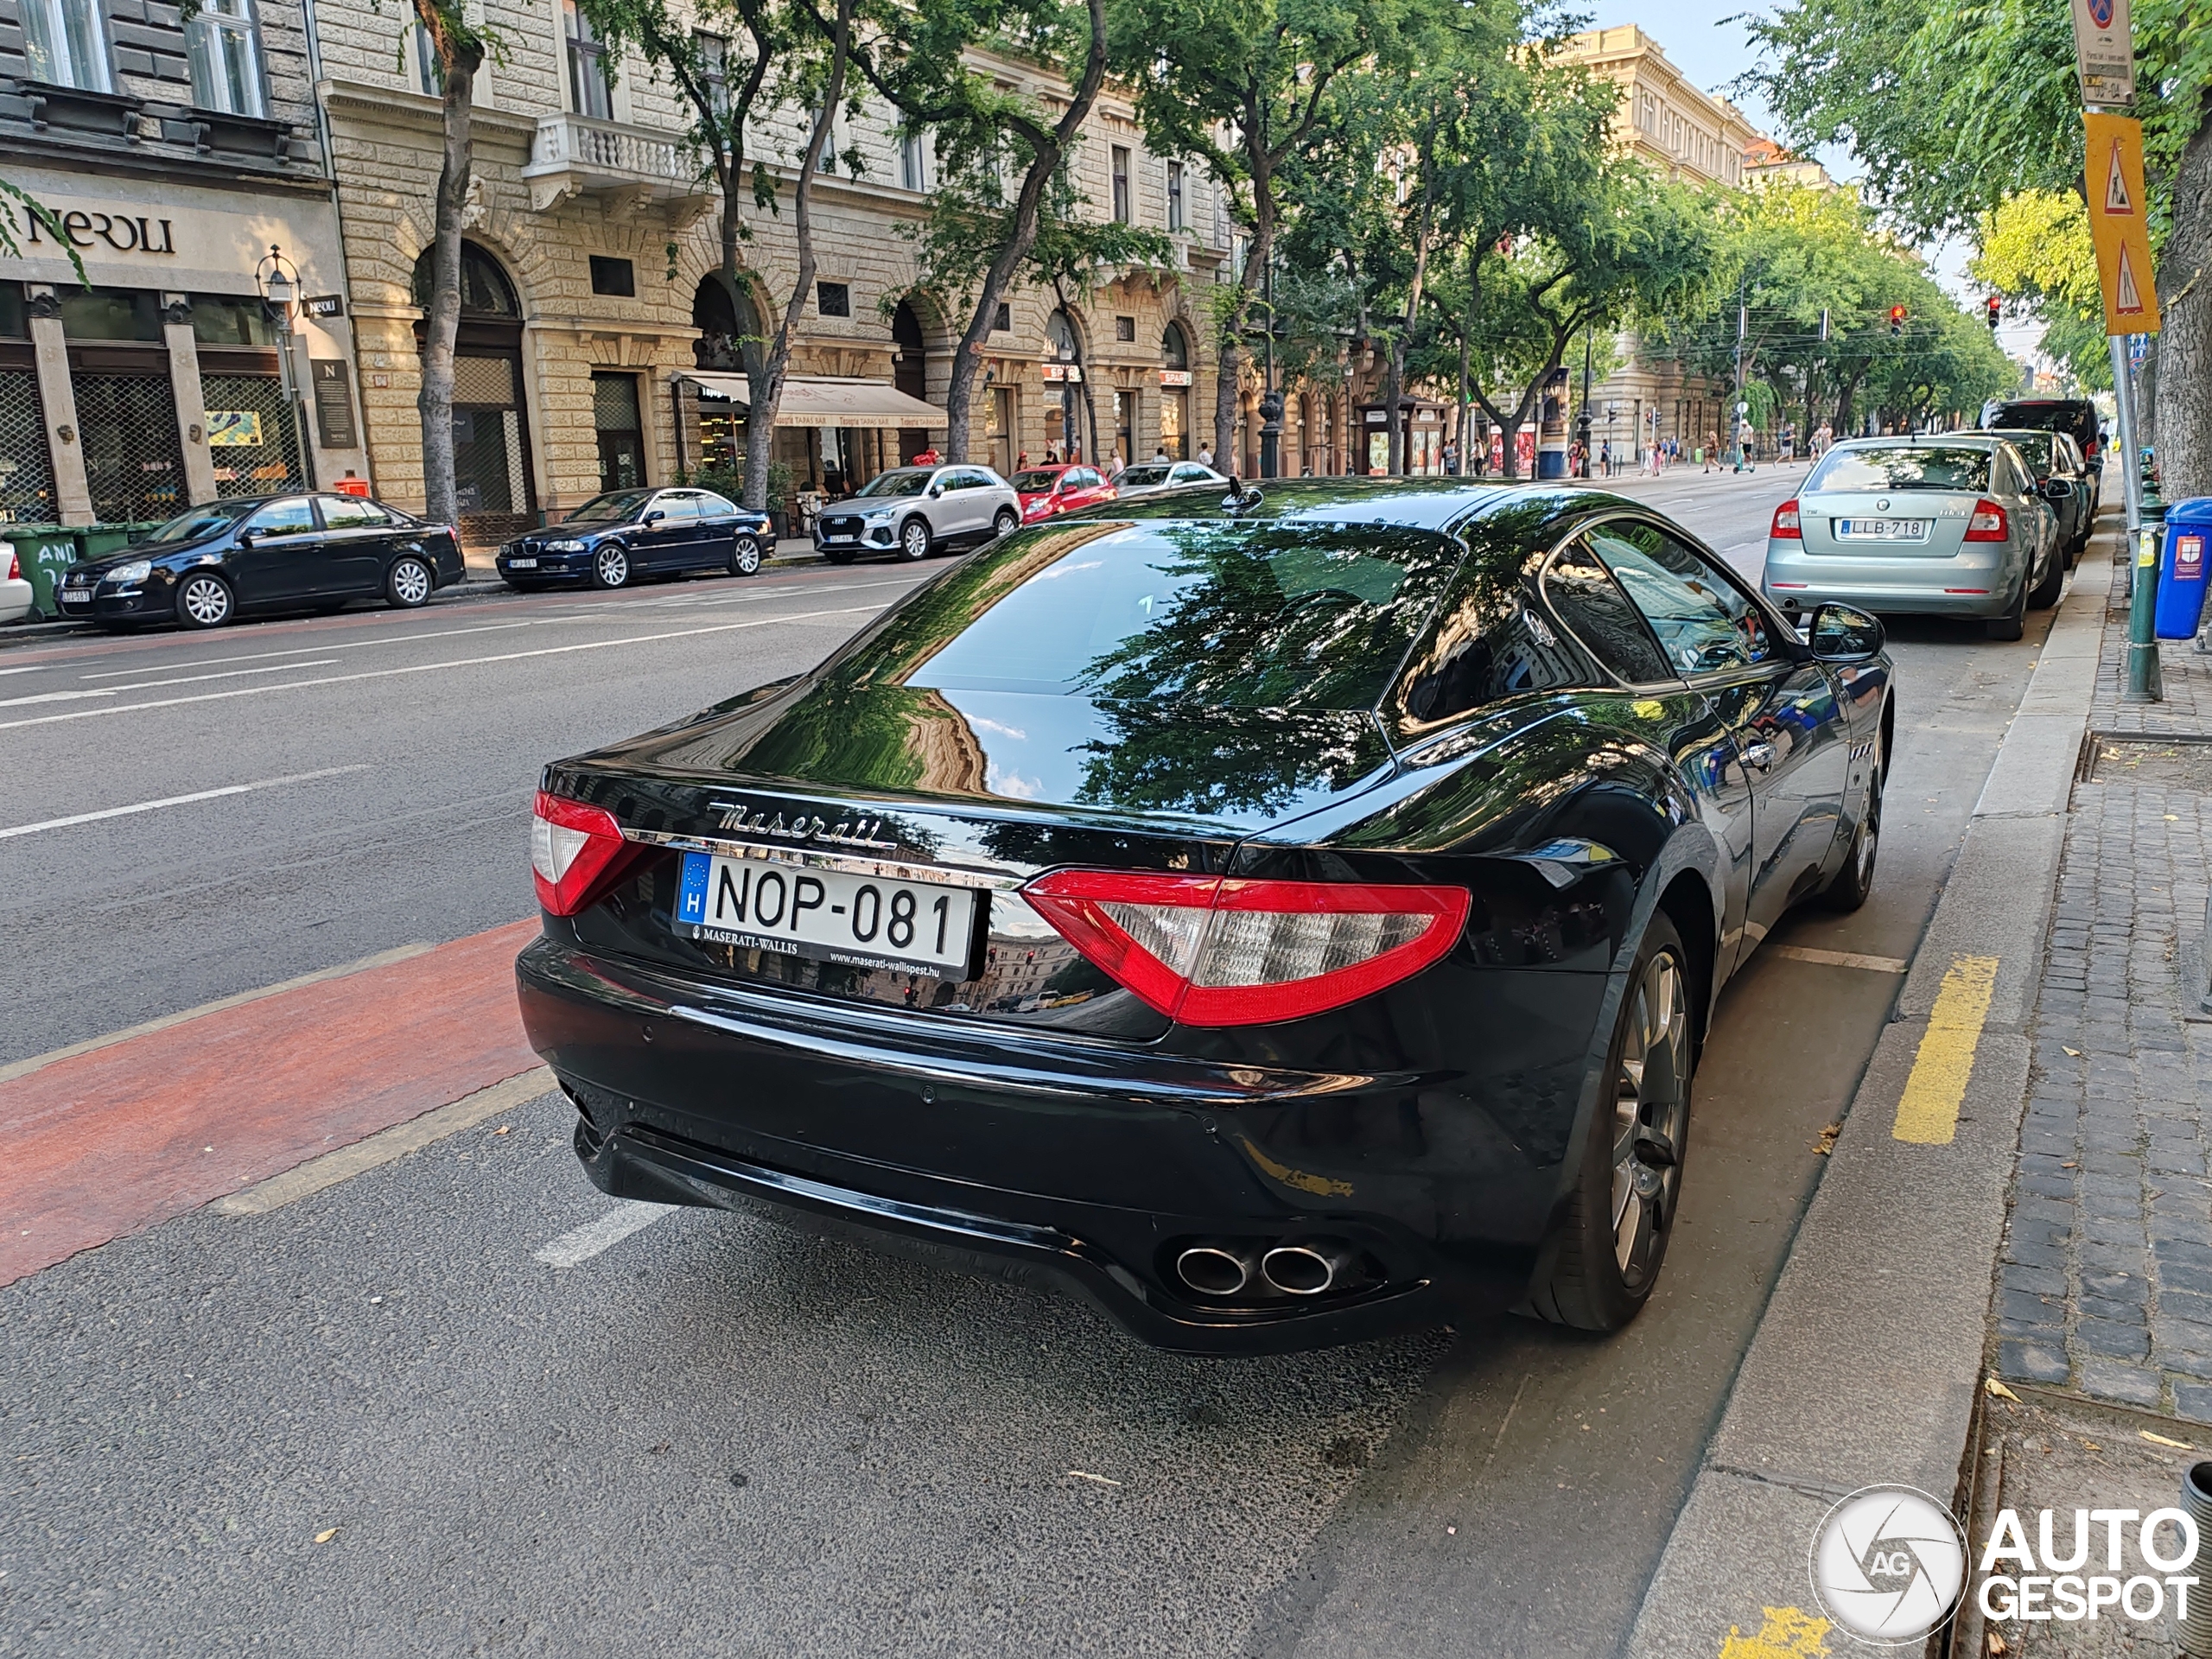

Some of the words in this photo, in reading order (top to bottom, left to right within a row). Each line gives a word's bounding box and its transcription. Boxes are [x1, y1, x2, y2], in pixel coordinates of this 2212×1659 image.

[1051, 367, 1075, 378] SPR
[1165, 373, 1185, 383] SPAR
[1853, 522, 1920, 535] LLB-718
[705, 802, 898, 850] Maserati
[687, 893, 700, 913] H
[715, 865, 951, 954] NOP-081
[703, 929, 798, 955] MASERATI-WALLIS
[830, 953, 940, 977] www.maserati-wallispest.hu
